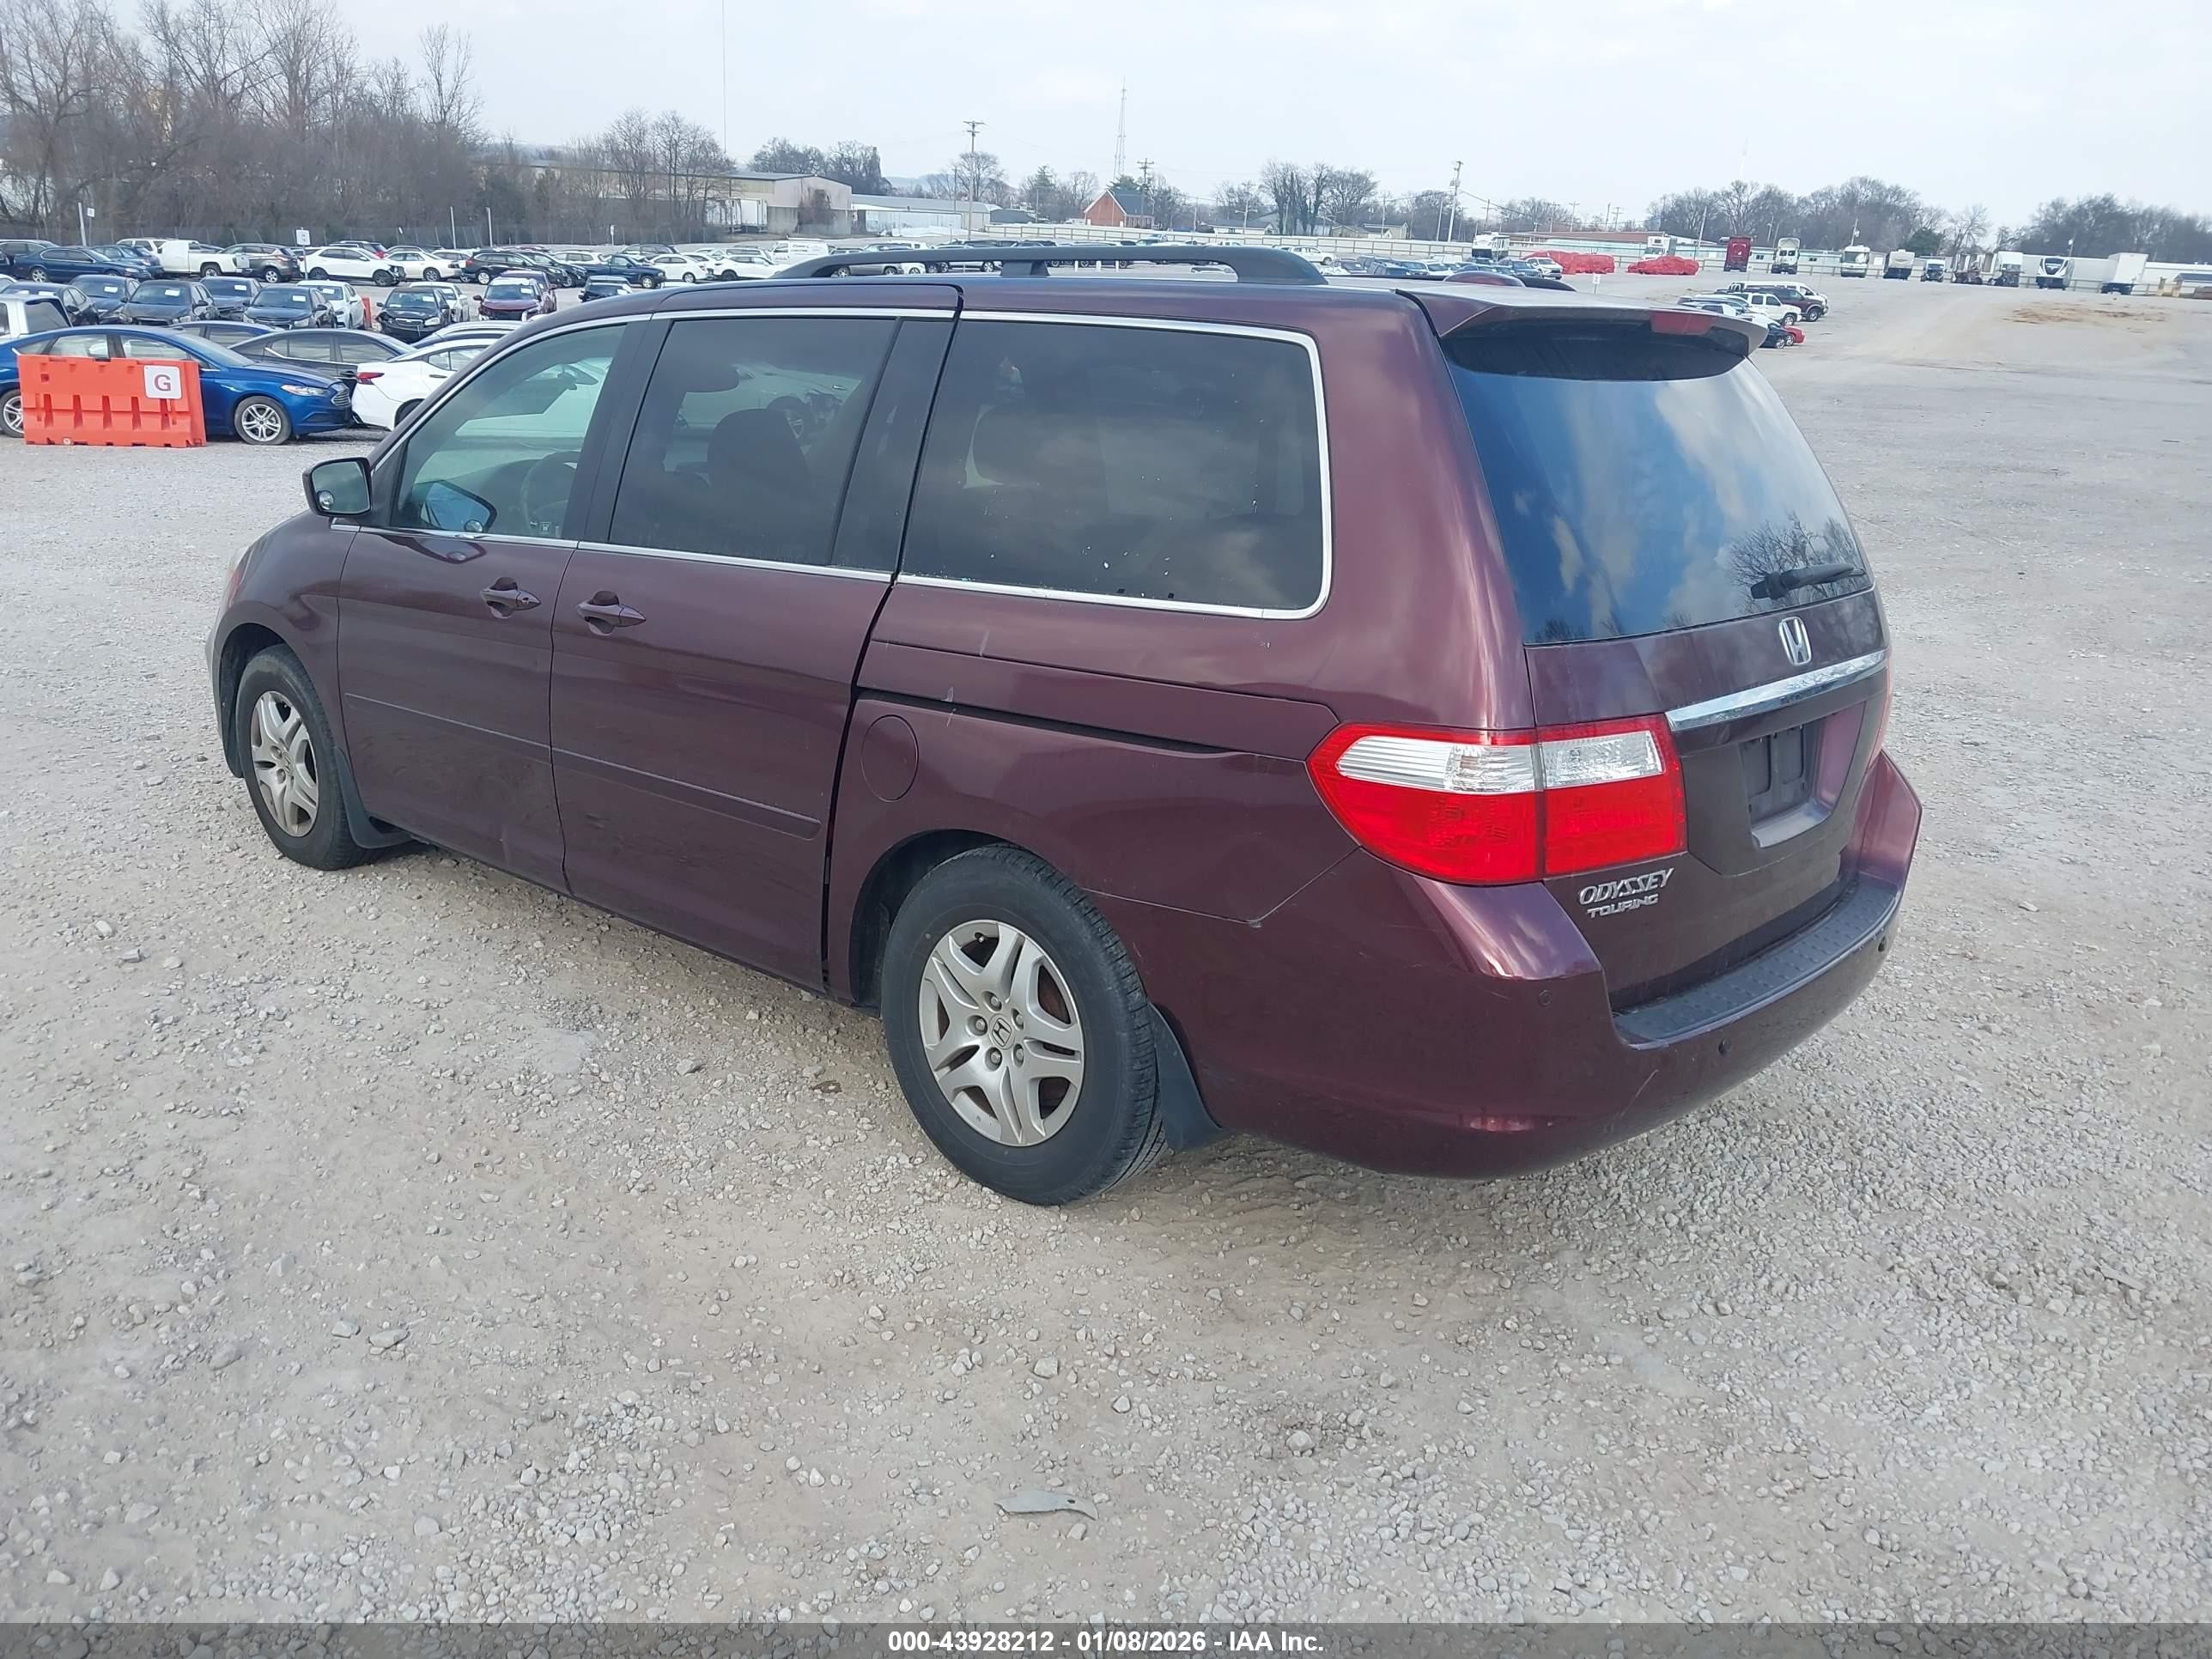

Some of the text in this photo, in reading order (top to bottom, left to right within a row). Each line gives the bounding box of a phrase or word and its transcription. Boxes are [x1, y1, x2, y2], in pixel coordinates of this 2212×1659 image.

[154, 374, 172, 392] G
[1579, 867, 1674, 905] ODYSSEY
[1586, 893, 1659, 919] TOURING
